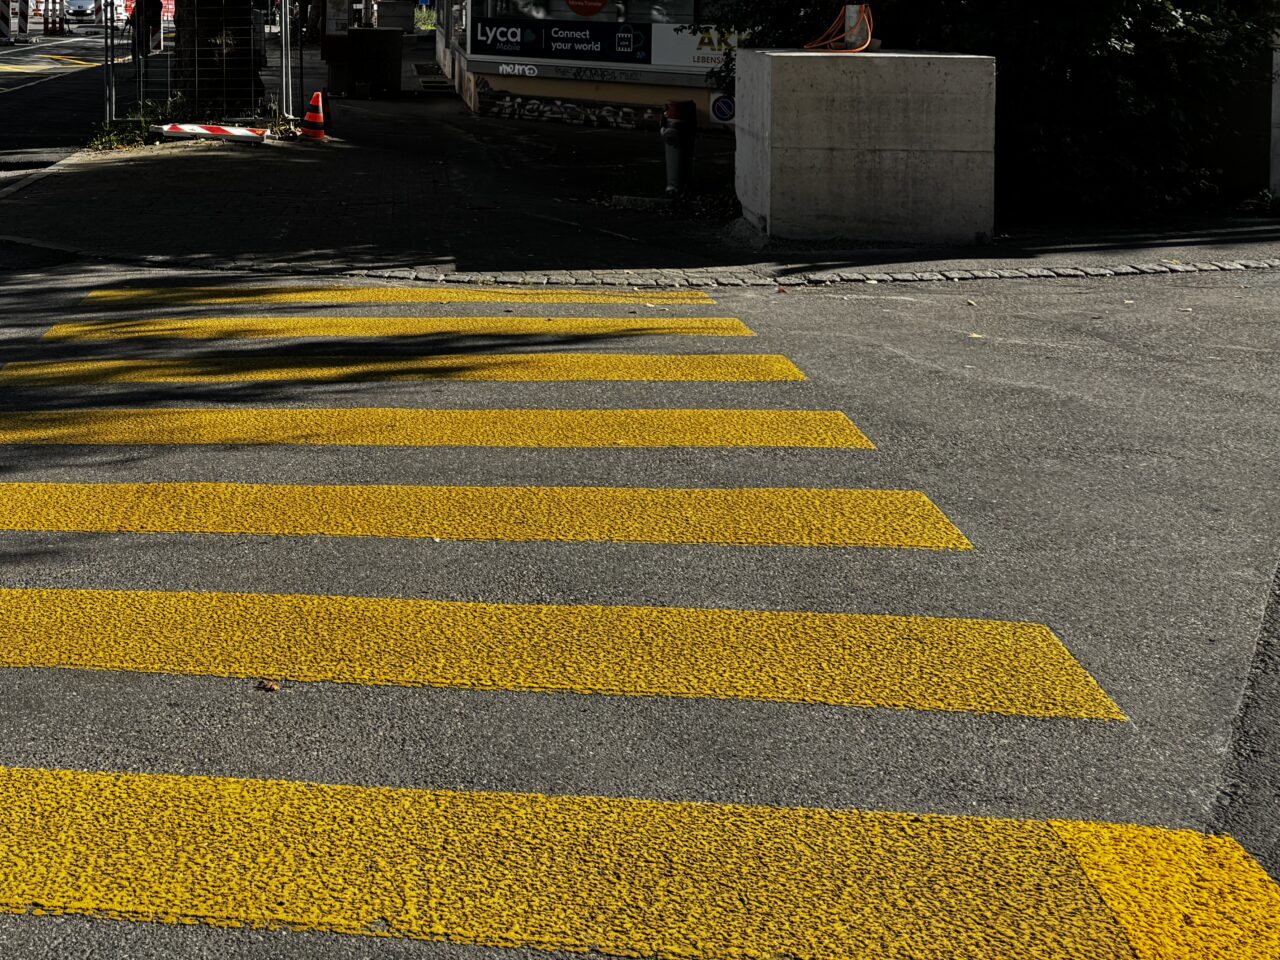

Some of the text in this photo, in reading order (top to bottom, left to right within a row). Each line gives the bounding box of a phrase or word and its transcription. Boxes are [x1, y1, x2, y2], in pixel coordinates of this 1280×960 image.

[477, 22, 521, 45] Lyca
[551, 27, 590, 39] Connect
[496, 42, 521, 51] Mobile
[551, 41, 601, 52] your world
